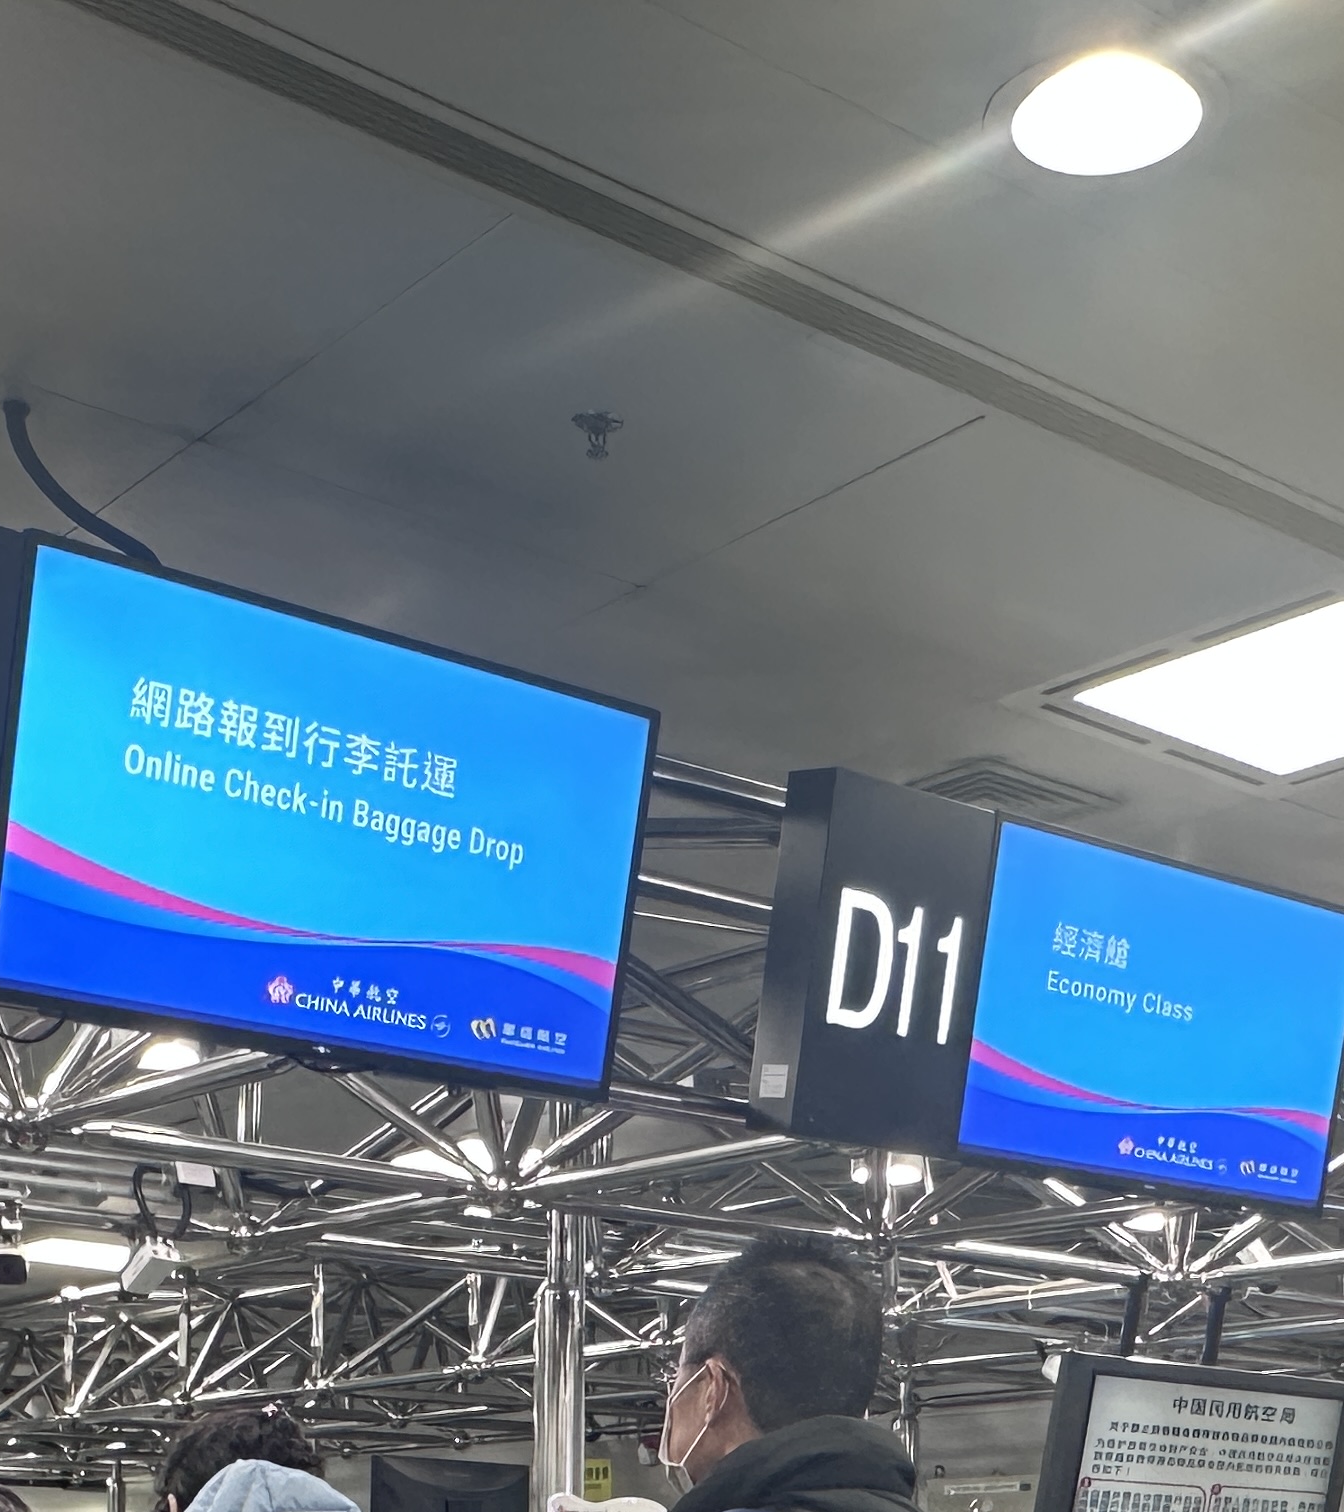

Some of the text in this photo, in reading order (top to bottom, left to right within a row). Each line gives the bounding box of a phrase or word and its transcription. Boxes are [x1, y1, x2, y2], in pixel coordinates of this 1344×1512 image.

[130, 677, 458, 799] 網路報到行李託運
[124, 744, 524, 871] Online Check-in Baggage Drop
[826, 887, 963, 1045] D11
[1053, 922, 1130, 970] 經濟艙
[295, 993, 426, 1030] CHINA AIRLINES
[1047, 969, 1193, 1022] Economy Class
